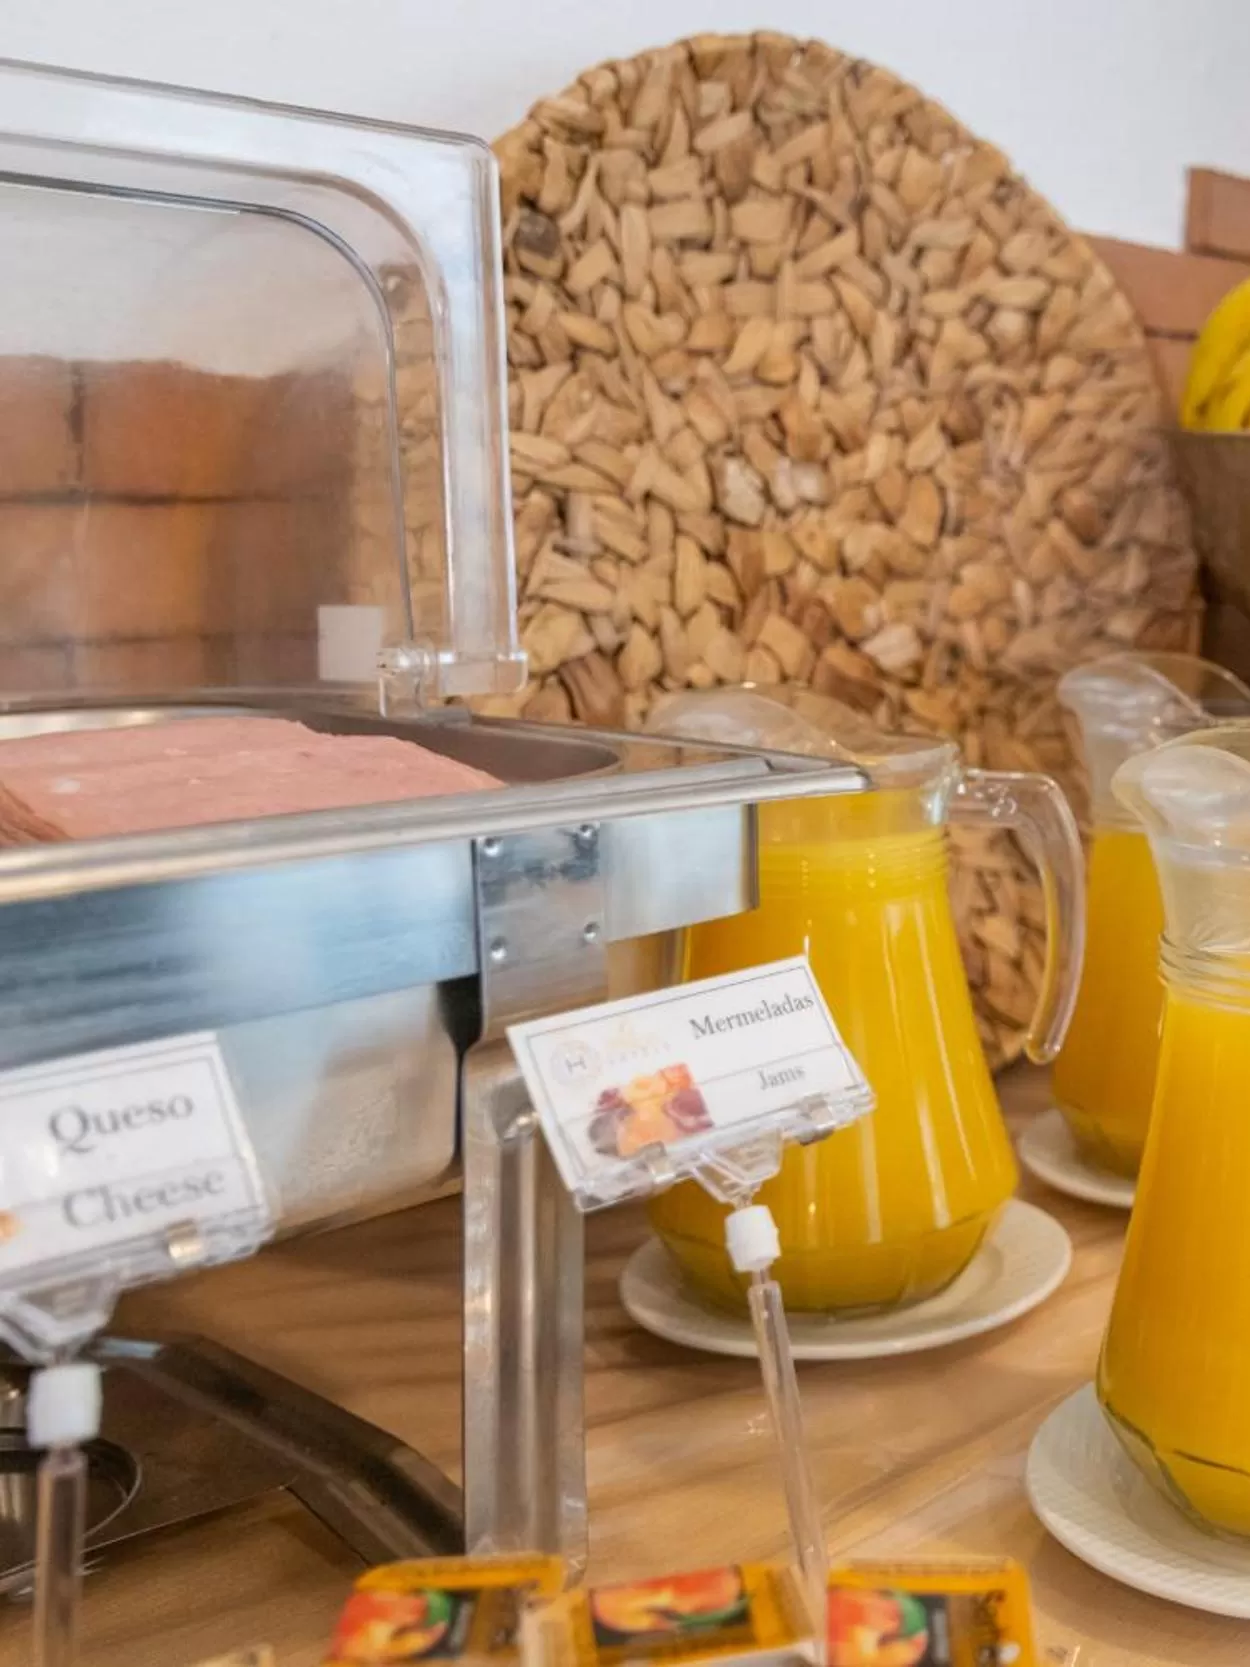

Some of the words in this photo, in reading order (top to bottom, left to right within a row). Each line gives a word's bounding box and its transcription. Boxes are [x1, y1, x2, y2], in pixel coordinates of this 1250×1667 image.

[689, 992, 814, 1039] Mermeladas
[758, 1066, 805, 1090] Jams
[48, 1094, 194, 1153] Queso
[62, 1171, 224, 1229] Cheese
